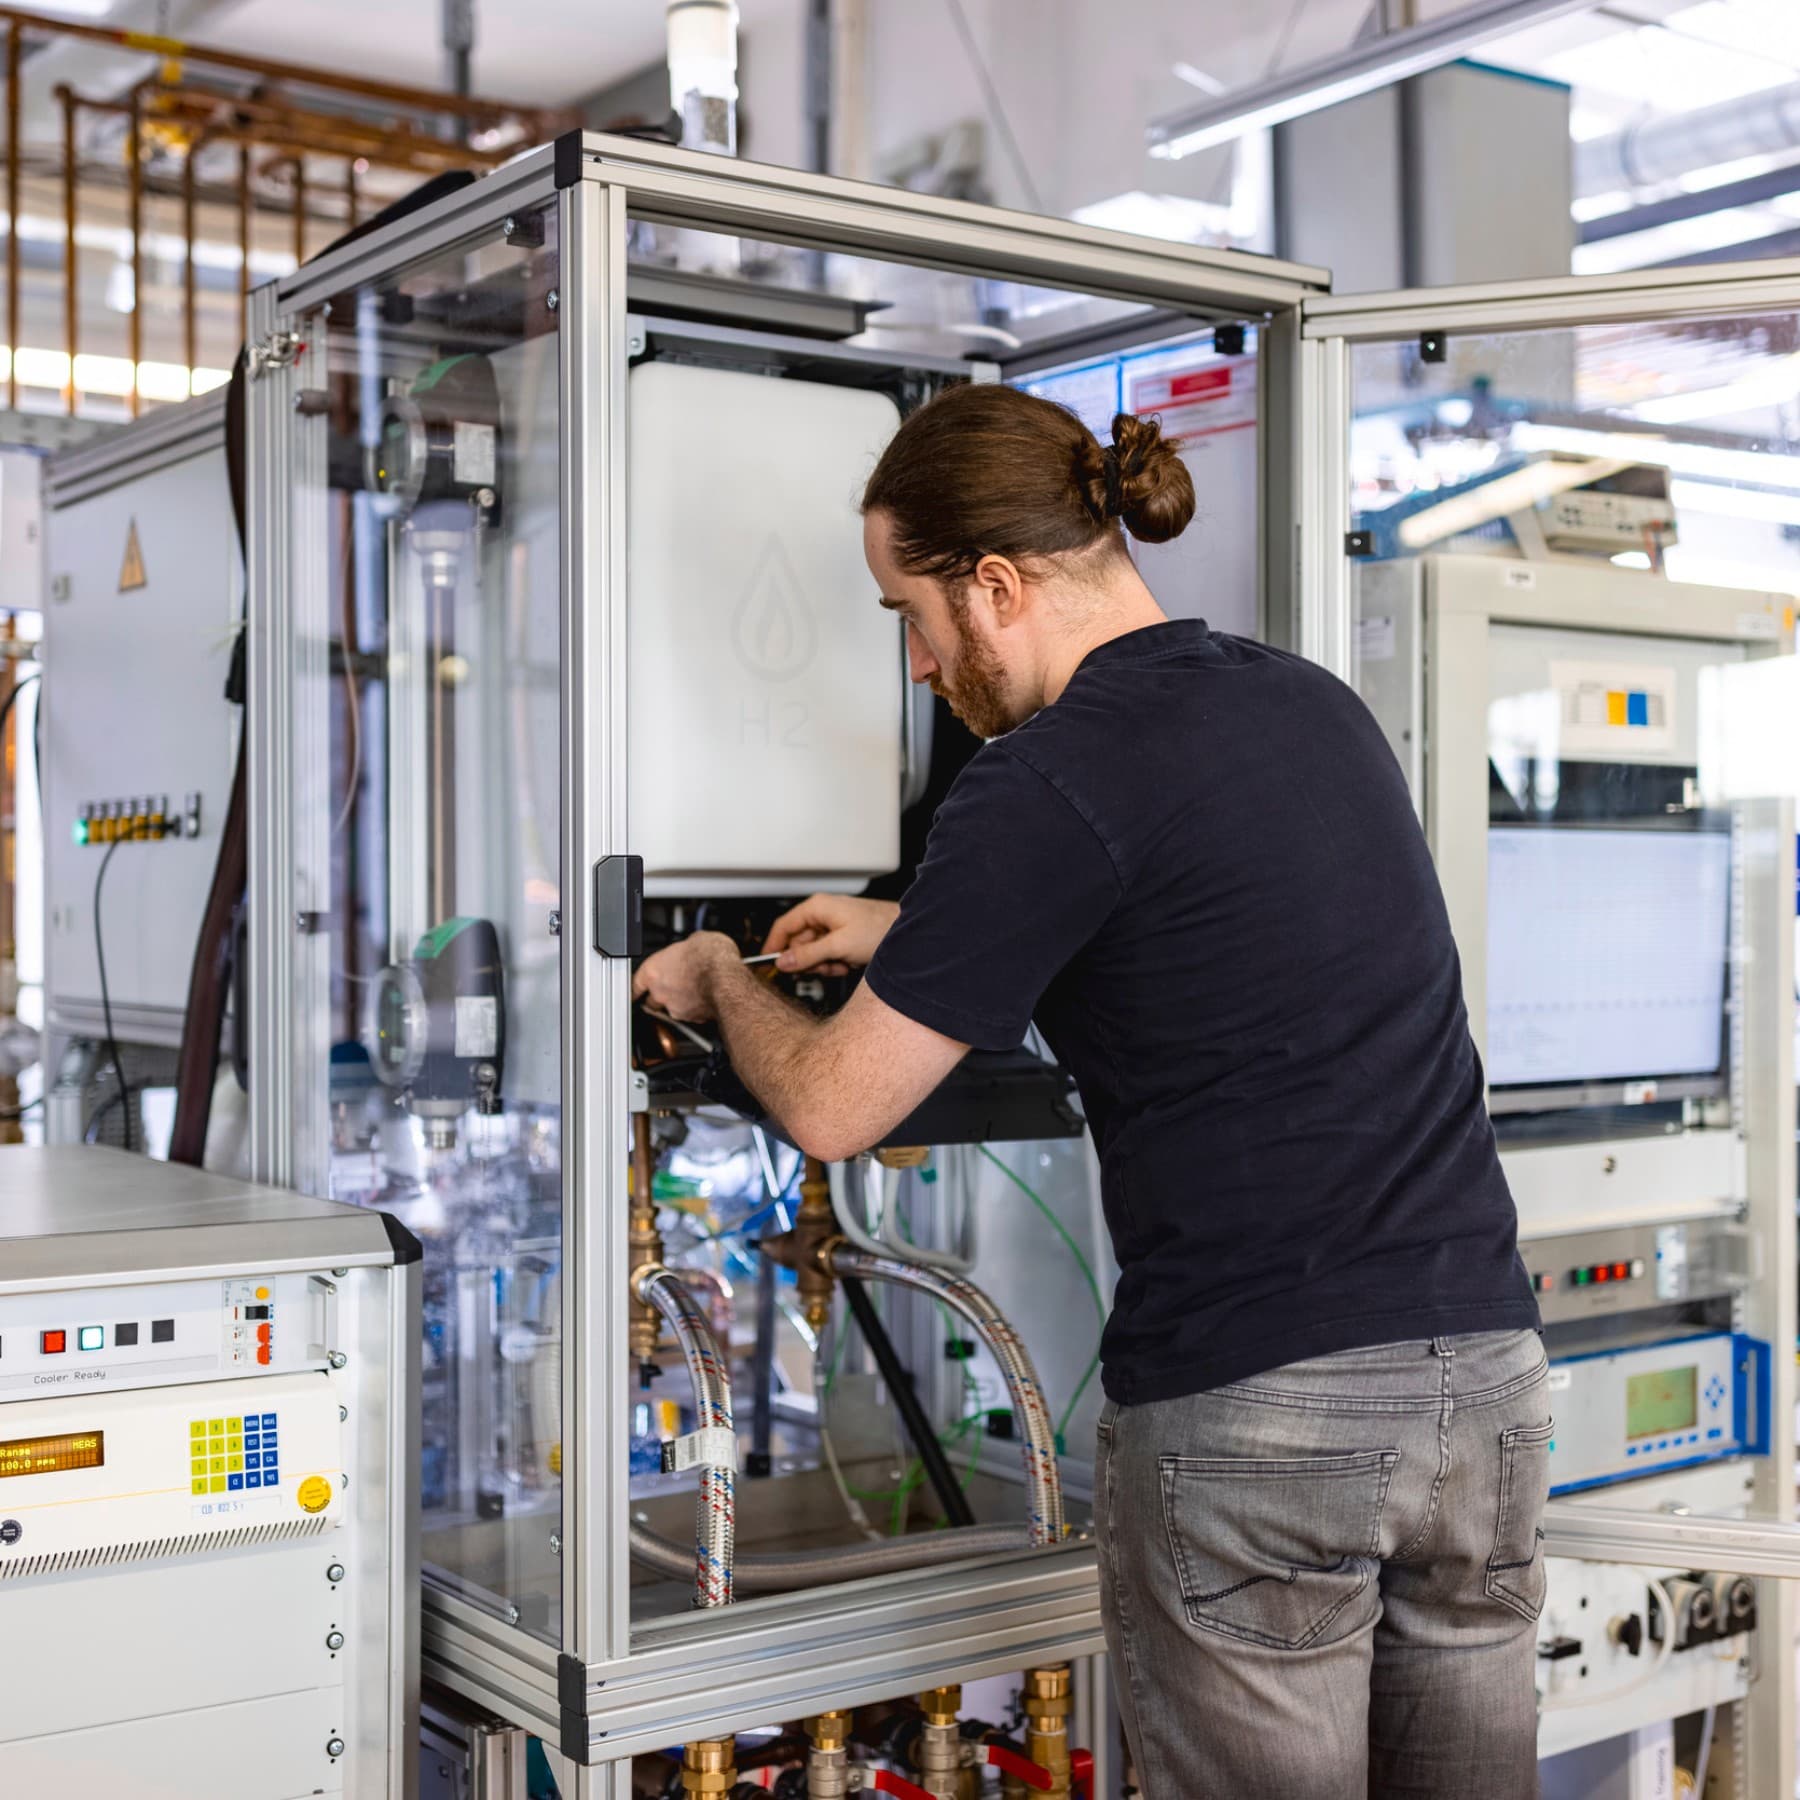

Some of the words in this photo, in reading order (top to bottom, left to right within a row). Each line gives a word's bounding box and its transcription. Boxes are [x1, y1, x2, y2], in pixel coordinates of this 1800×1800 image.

[740, 699, 809, 748] H2
[33, 1375, 69, 1385] Cooler
[74, 1369, 106, 1380] Ready
[0, 1447, 31, 1458] Range
[72, 1437, 97, 1450] MEAS
[1, 1459, 31, 1471] 100.0
[37, 1458, 56, 1467] ppm
